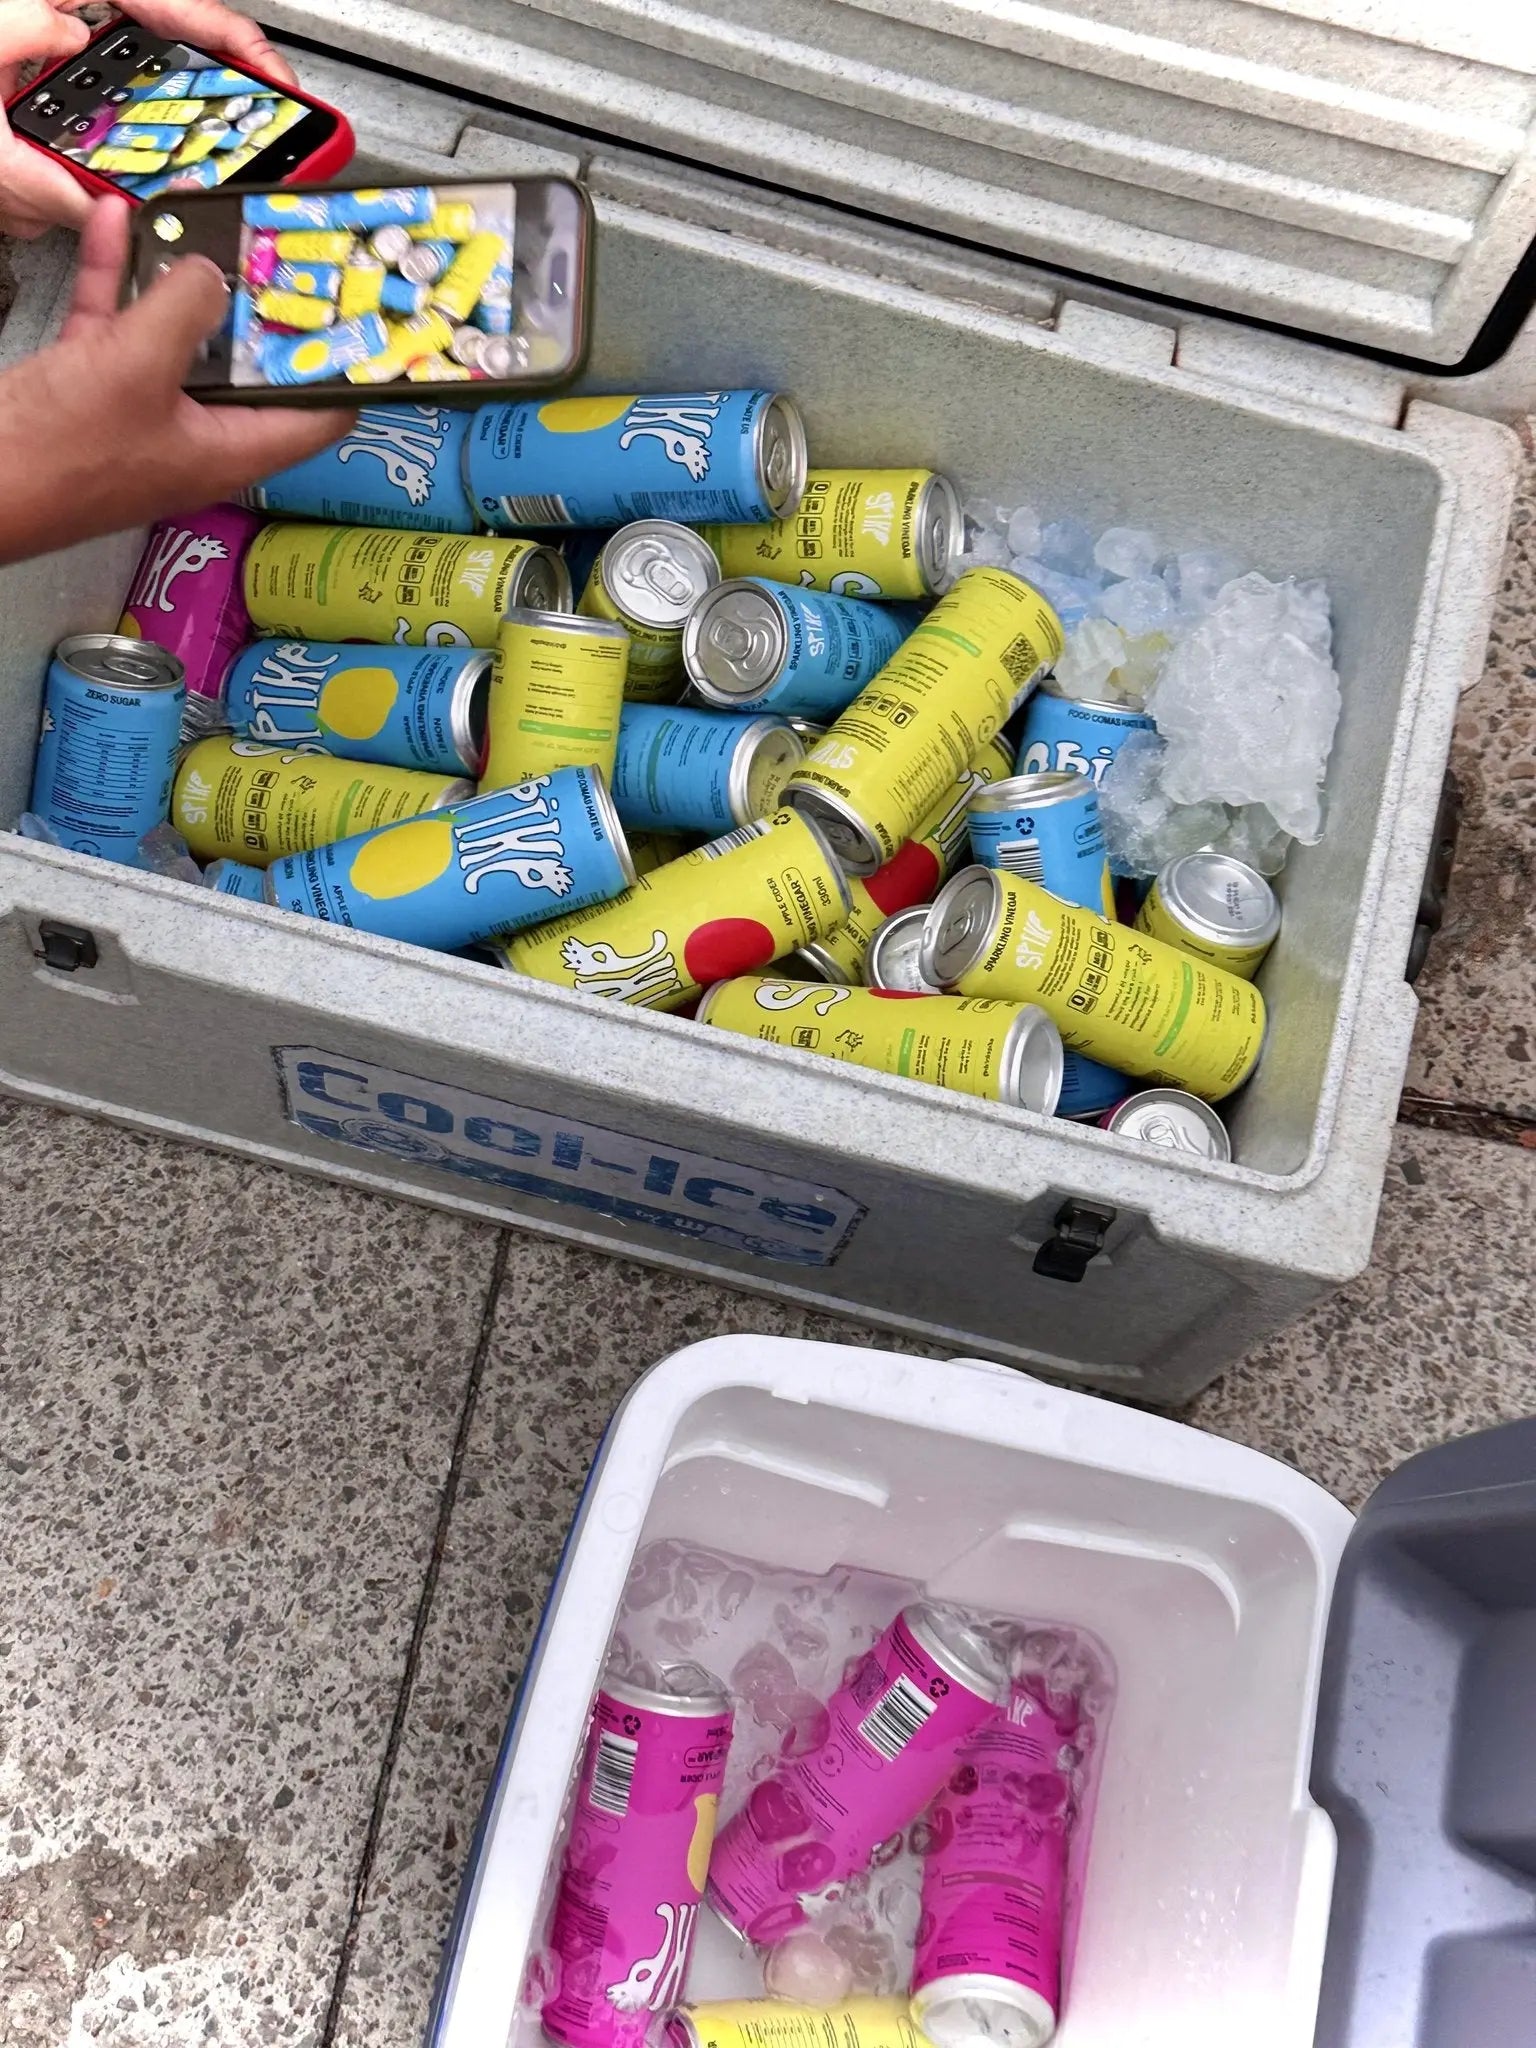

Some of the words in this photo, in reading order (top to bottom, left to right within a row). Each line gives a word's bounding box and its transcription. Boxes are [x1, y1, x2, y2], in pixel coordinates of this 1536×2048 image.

[901, 521, 911, 559] VINEGAR
[85, 688, 109, 703] ZERO
[110, 695, 142, 708] SUGAR
[586, 805, 600, 828] HATE
[593, 827, 604, 842] US
[311, 882, 331, 922] VINEGA
[332, 885, 349, 912] APPLE
[766, 877, 784, 903] CIDER
[812, 876, 832, 907] 330ml
[777, 902, 794, 927] APPLE
[983, 924, 1012, 973] SPARKLING
[1004, 891, 1017, 926] VINEGAR
